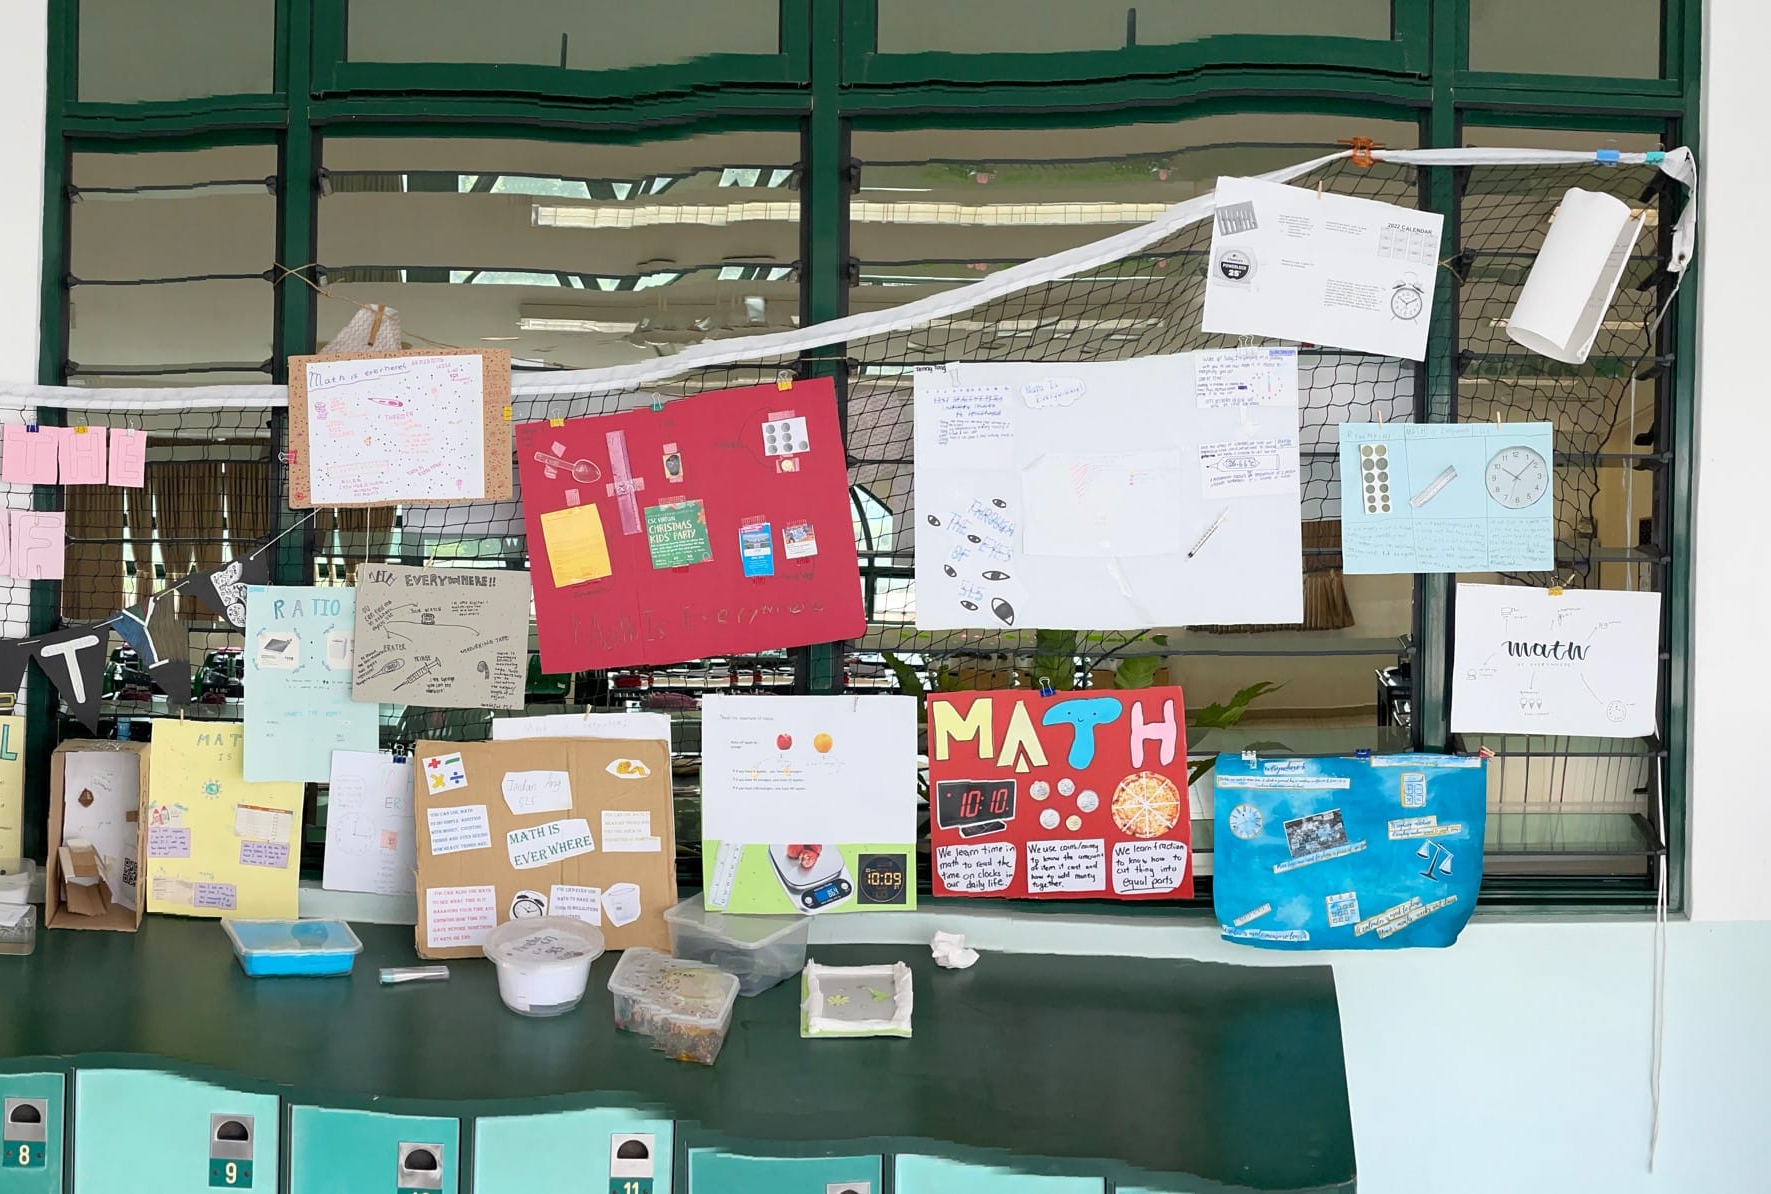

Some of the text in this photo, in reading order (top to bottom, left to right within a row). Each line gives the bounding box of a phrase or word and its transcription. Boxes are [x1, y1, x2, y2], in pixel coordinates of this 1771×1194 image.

[1387, 222, 1433, 234] 2022 CALENDAR
[308, 370, 346, 388] Math
[7, 431, 138, 480] THE
[648, 520, 693, 534] CHRISTMAS
[673, 529, 697, 541] PARTY
[273, 598, 341, 620] RATIO
[1501, 640, 1591, 662] math
[932, 697, 1177, 773] MATH
[509, 824, 561, 845] MATH IS
[938, 845, 1015, 858] We learn time in
[1028, 845, 1042, 855] We
[1042, 846, 1057, 854] use
[1114, 847, 1131, 857] We
[1133, 844, 1152, 852] learn
[939, 856, 1012, 871] math to read the
[1031, 856, 1040, 866] to
[1063, 853, 1075, 861] the
[1116, 854, 1183, 868] to know how to
[1031, 864, 1040, 873] of
[1040, 863, 1056, 872] item
[1057, 863, 1065, 871] it
[1084, 862, 1098, 870] and
[1116, 865, 1178, 877] cut thing into
[867, 872, 902, 886] 10:09
[941, 871, 960, 881] time
[962, 872, 975, 881] on
[977, 869, 1002, 880] clocks
[1046, 873, 1055, 882] to
[946, 881, 961, 889] our
[965, 877, 985, 890] daily
[1122, 876, 1174, 889] equal parts
[18, 1144, 30, 1165] 8
[225, 1162, 237, 1184] 9
[623, 1182, 639, 1194] 11
